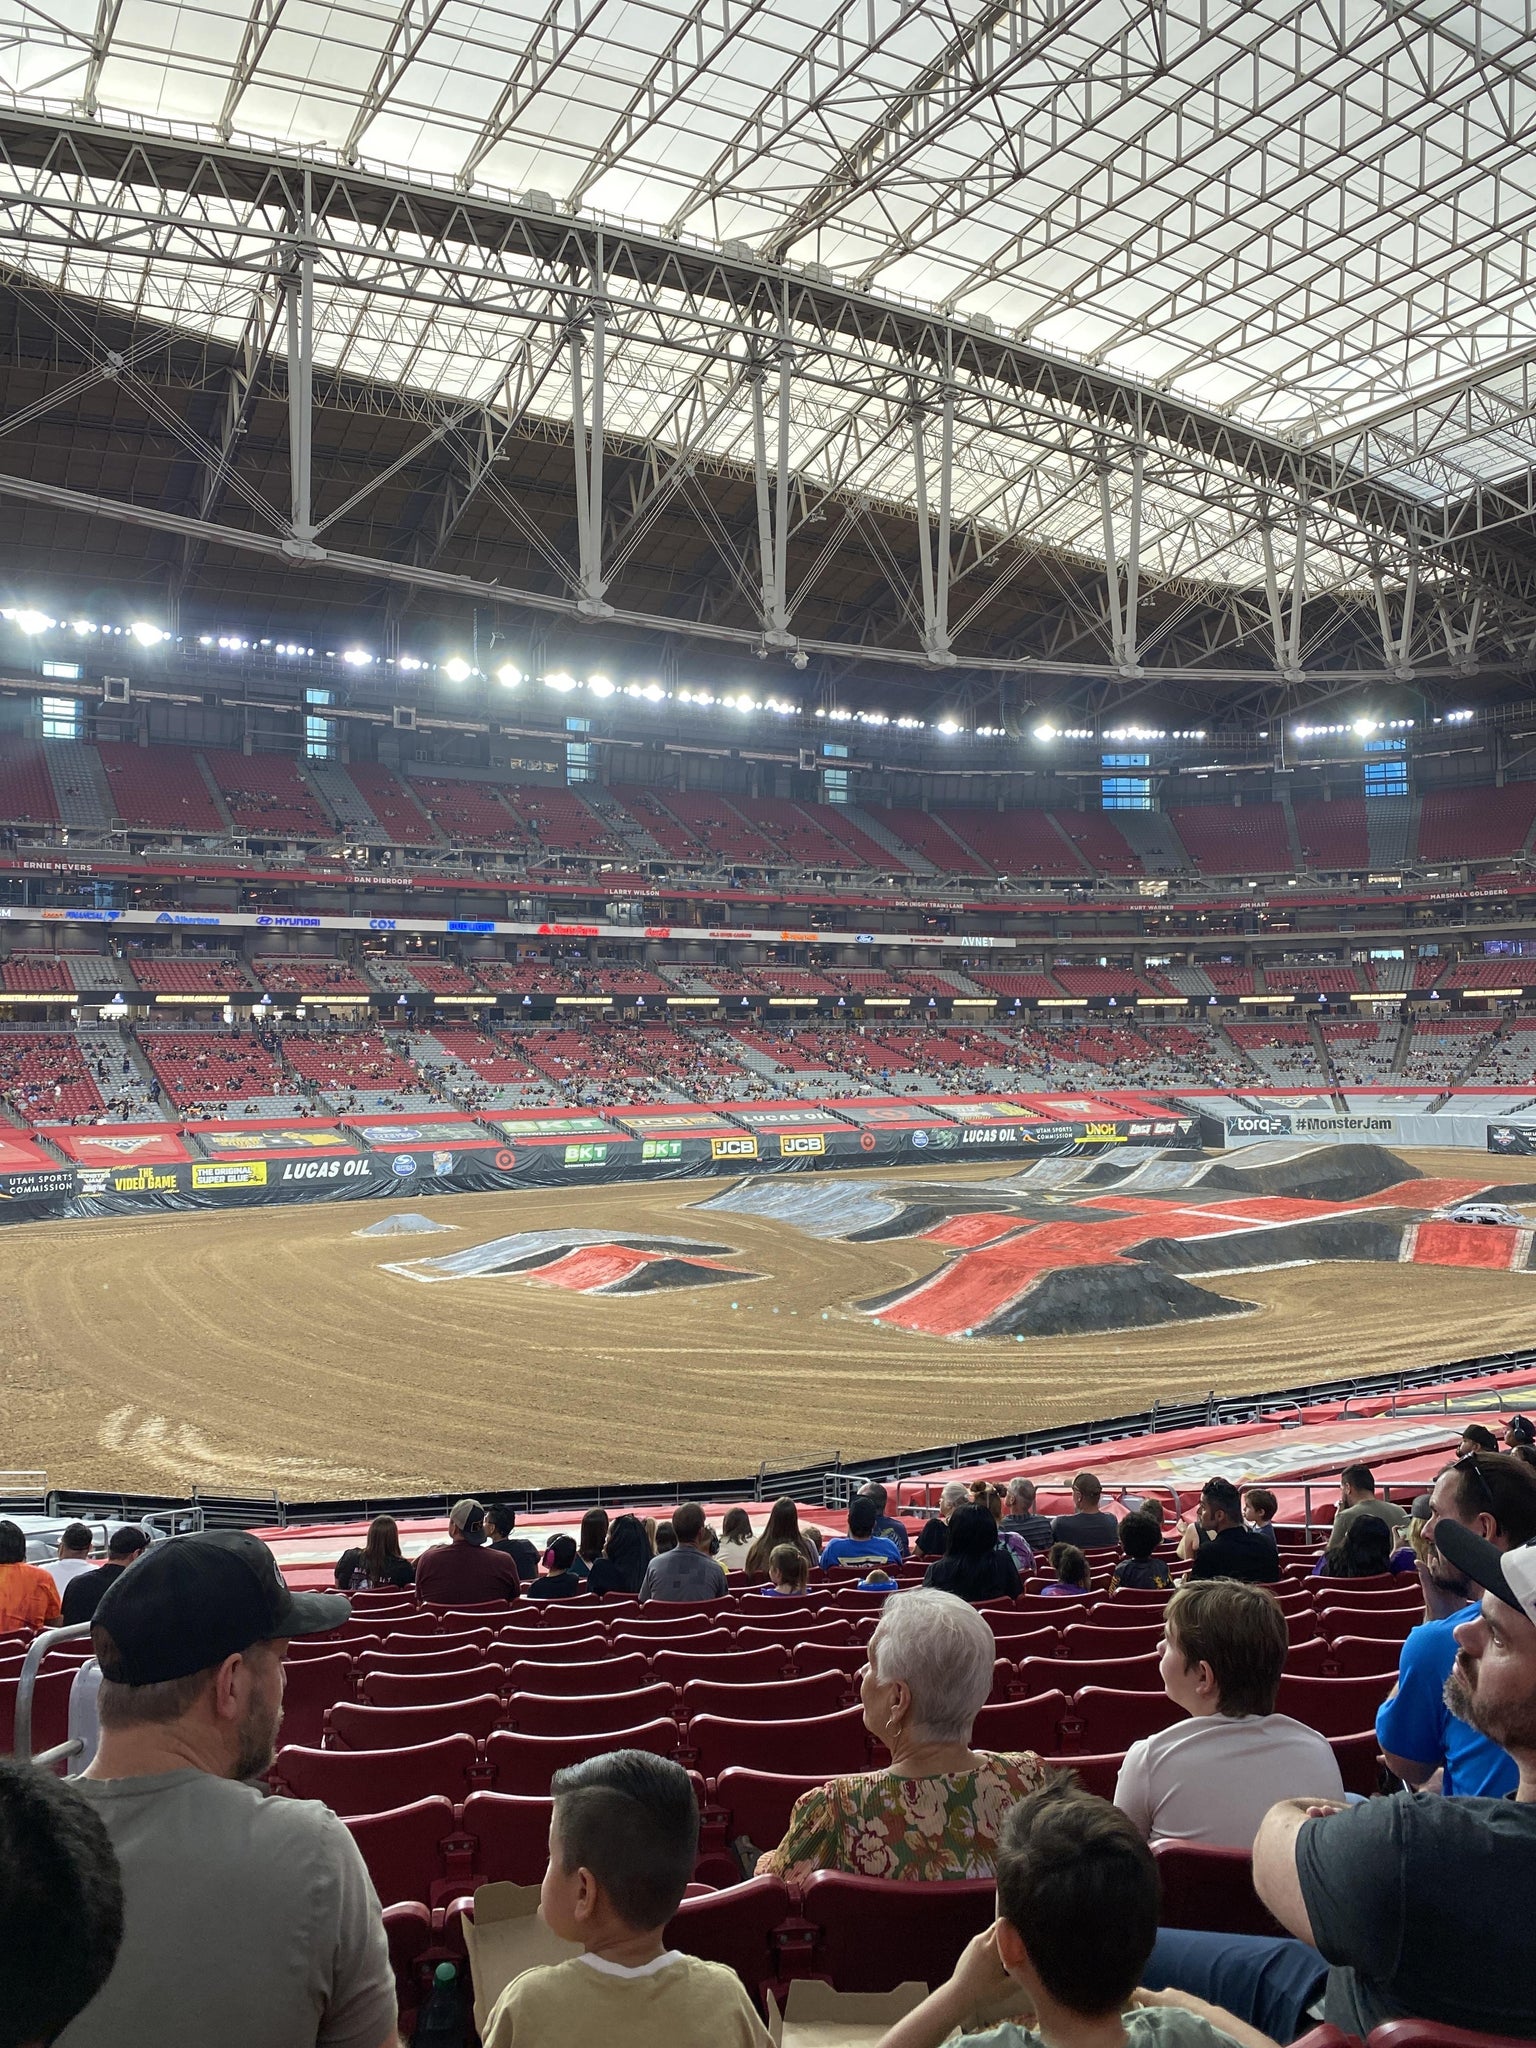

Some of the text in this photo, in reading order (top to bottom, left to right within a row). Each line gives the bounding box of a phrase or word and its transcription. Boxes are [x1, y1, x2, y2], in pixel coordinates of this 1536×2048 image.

[24, 861, 52, 869] ERNIE
[55, 863, 93, 871] NEVERS
[373, 877, 413, 885] DIERDORF
[1430, 892, 1468, 900] MARSHALL
[1470, 889, 1509, 897] GOLDBERG
[275, 917, 321, 927] HYUNDAI
[369, 919, 397, 930] COX
[961, 937, 995, 947] AVNET
[742, 1112, 835, 1122] LUCAS OIL
[1085, 1122, 1116, 1135] UNOH
[1295, 1118, 1392, 1131] #MonsterJam
[963, 1128, 997, 1143] LUCAS
[1036, 1132, 1073, 1140] COMMISSION
[643, 1142, 681, 1158] BKT
[716, 1140, 754, 1155] JCB
[784, 1137, 822, 1152] JCB
[565, 1146, 606, 1161] BKT
[138, 1167, 154, 1178] THE
[197, 1166, 253, 1176] THE ORIGINAL
[283, 1161, 341, 1180] LUCAS
[9, 1173, 73, 1186] UTAH SPORTS
[115, 1177, 146, 1191] VIDEO
[147, 1175, 177, 1189] GAME
[197, 1174, 250, 1184] SUPER GLUE
[9, 1182, 73, 1195] COMMISSION
